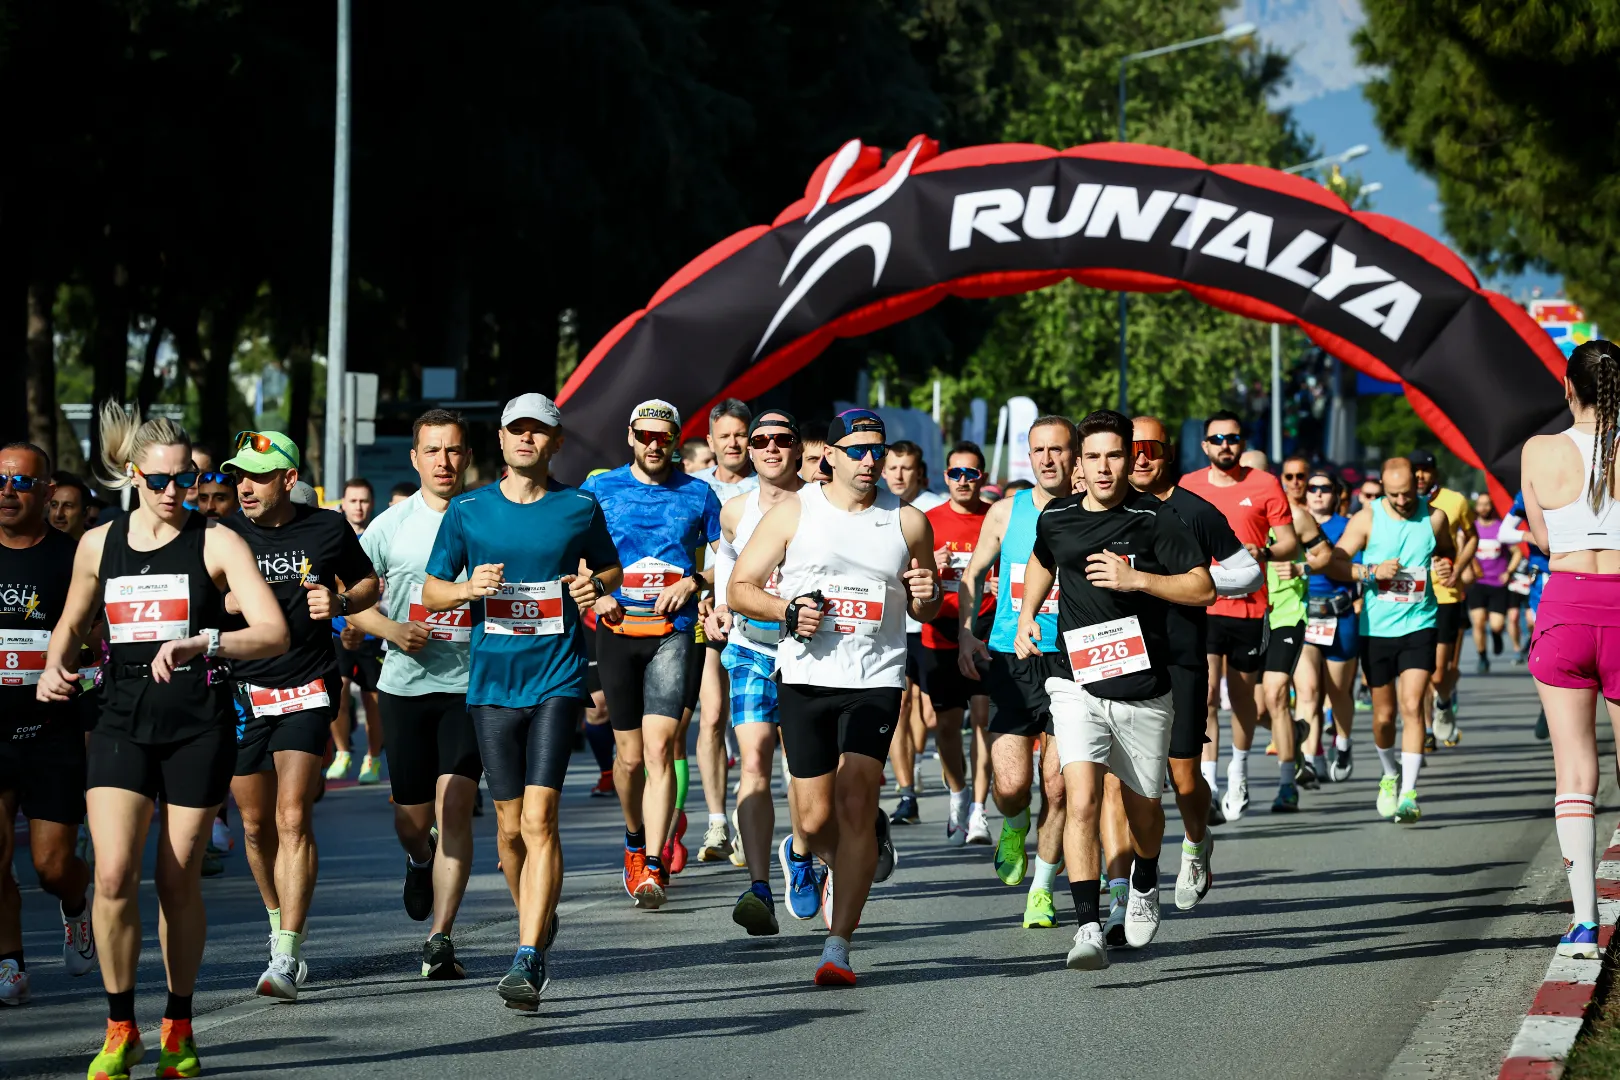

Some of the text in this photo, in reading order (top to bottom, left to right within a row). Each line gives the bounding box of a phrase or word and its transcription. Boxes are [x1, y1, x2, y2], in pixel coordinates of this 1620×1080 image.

[948, 183, 1422, 342] RUNTALYA
[256, 550, 305, 560] UNNER'S
[642, 573, 665, 587] 22
[1389, 580, 1417, 593] 239
[119, 585, 134, 595] 20
[502, 586, 515, 595] 20
[828, 584, 841, 594] 20
[129, 601, 162, 622] 74
[511, 601, 539, 618] 96
[827, 599, 867, 619] 283
[424, 610, 465, 626] 227
[1082, 633, 1096, 644] 20
[5, 652, 19, 669] 8
[1087, 641, 1129, 666] 226
[269, 683, 311, 703] 118
[16, 724, 42, 733] COMP
[12, 732, 37, 740] RESS
